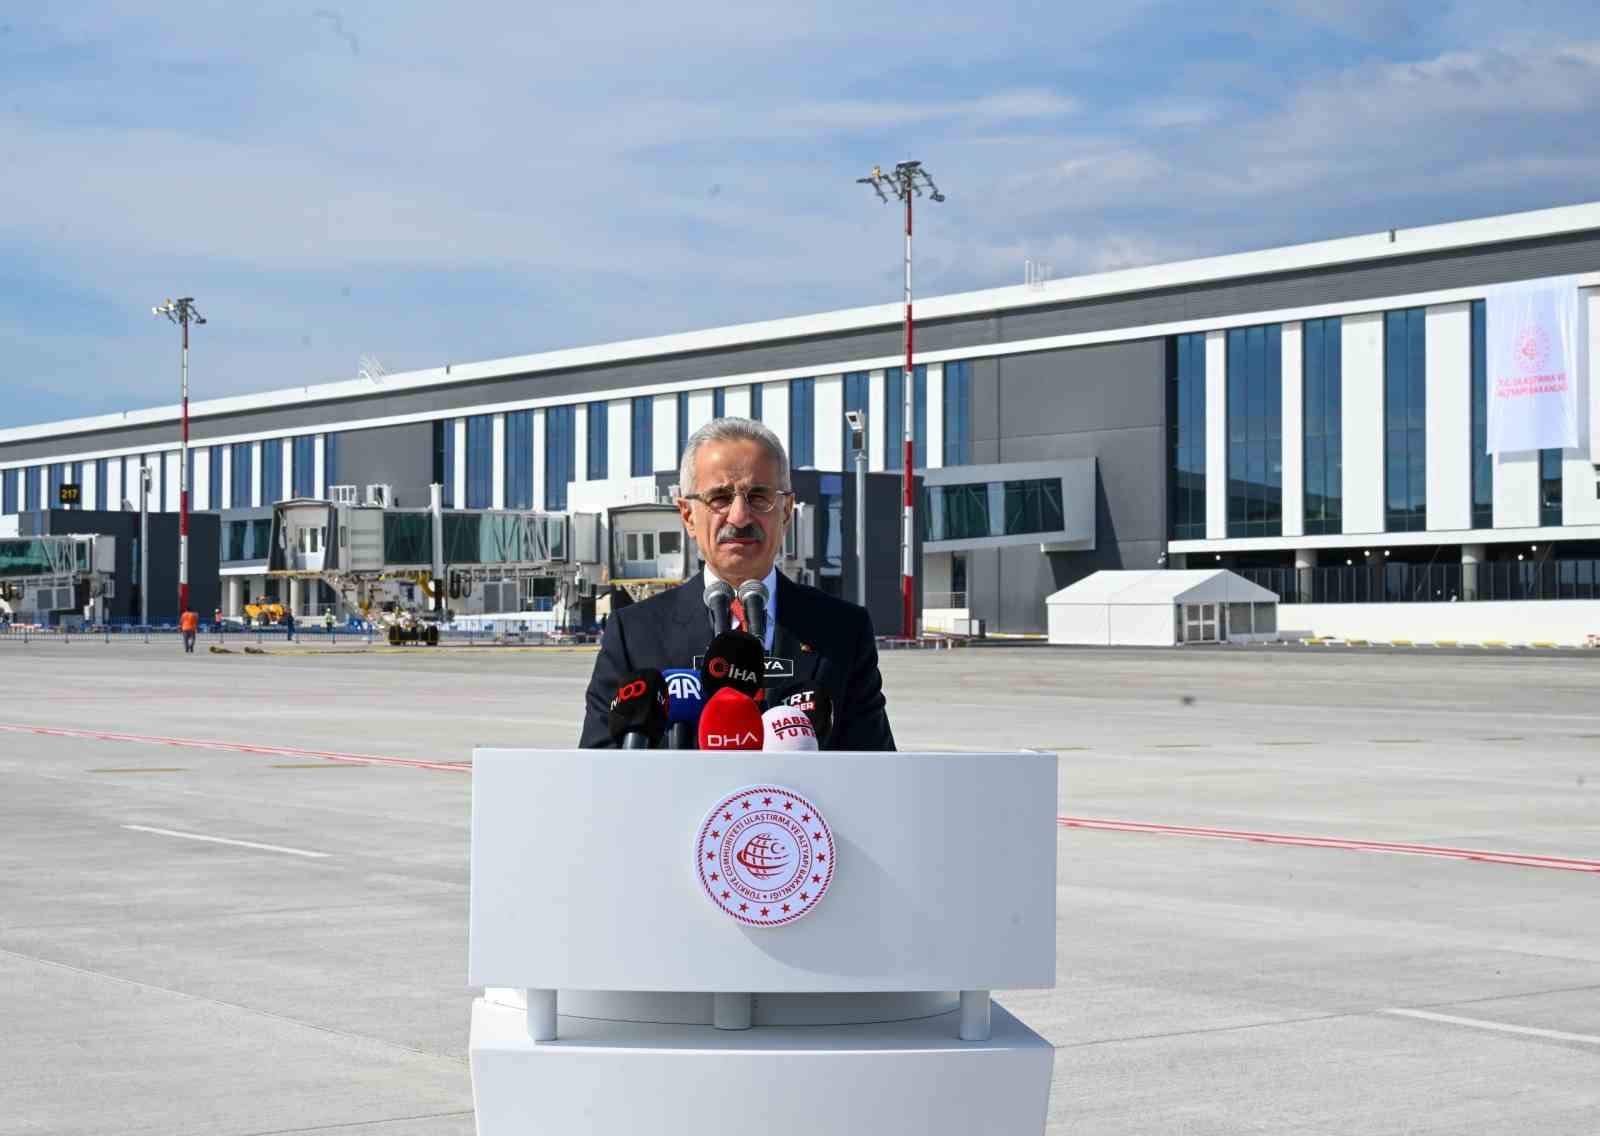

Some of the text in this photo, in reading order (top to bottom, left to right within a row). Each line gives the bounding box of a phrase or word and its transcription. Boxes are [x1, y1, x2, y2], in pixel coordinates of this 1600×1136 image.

[61, 488, 77, 499] 217
[668, 677, 702, 700] AA
[707, 731, 758, 746] DHA
[790, 823, 801, 835] VE
